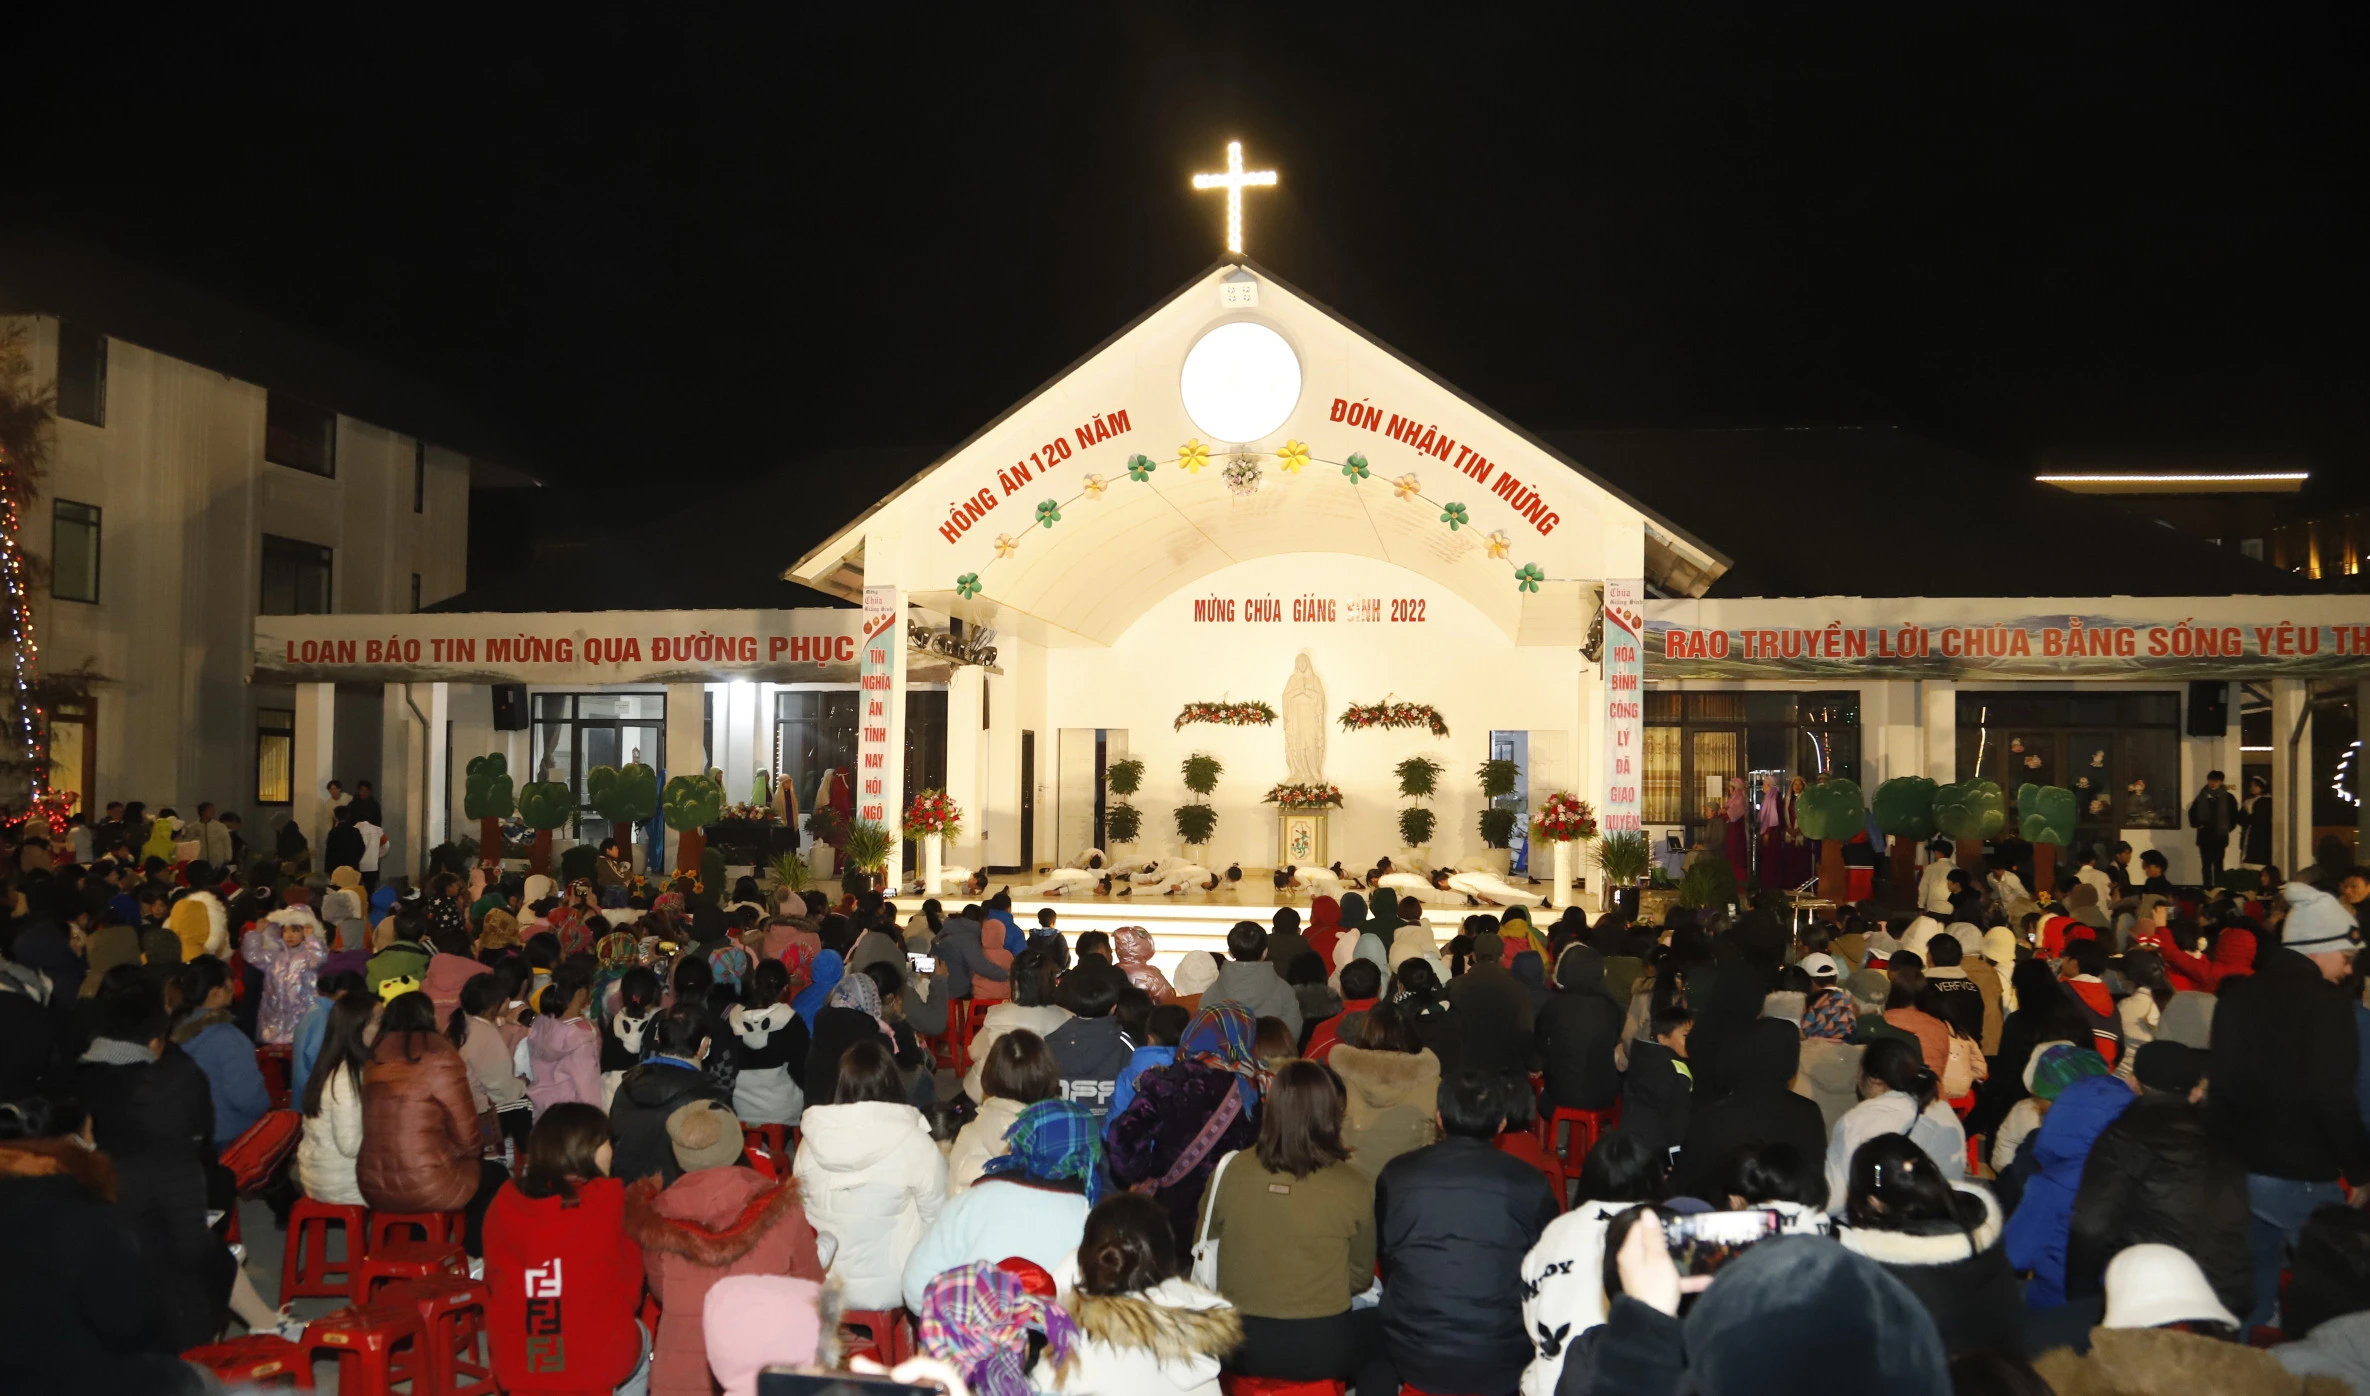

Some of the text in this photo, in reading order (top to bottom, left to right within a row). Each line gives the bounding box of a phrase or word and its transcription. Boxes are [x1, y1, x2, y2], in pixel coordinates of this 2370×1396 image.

[938, 409, 1132, 545] HỒNG ÂN 120 NĂM
[1330, 397, 1560, 537] ĐÓN NHẬN TIN MỪNG
[1194, 592, 1235, 622] MỪNG
[1244, 592, 1282, 622] CHÚA
[1391, 598, 1426, 622] 2022
[1665, 630, 1729, 659] RAO
[1740, 620, 1867, 659] TRUYỀN
[1878, 620, 1930, 658] LỜI
[1940, 622, 2031, 657] CHÚA
[2042, 616, 2135, 657] BẰNG
[2148, 617, 2242, 657] SỐNG
[2253, 620, 2319, 656] YÊU
[286, 630, 854, 667] LOAN BÁO TIN MỪNG QUA ĐƯỜNG PHỤC
[861, 673, 891, 690] NGHĨA
[869, 699, 883, 716] ÂN
[1609, 699, 1638, 718] CÔNG
[865, 753, 883, 768] NAY
[865, 776, 882, 797] HỘI
[1610, 787, 1635, 802] GIAO
